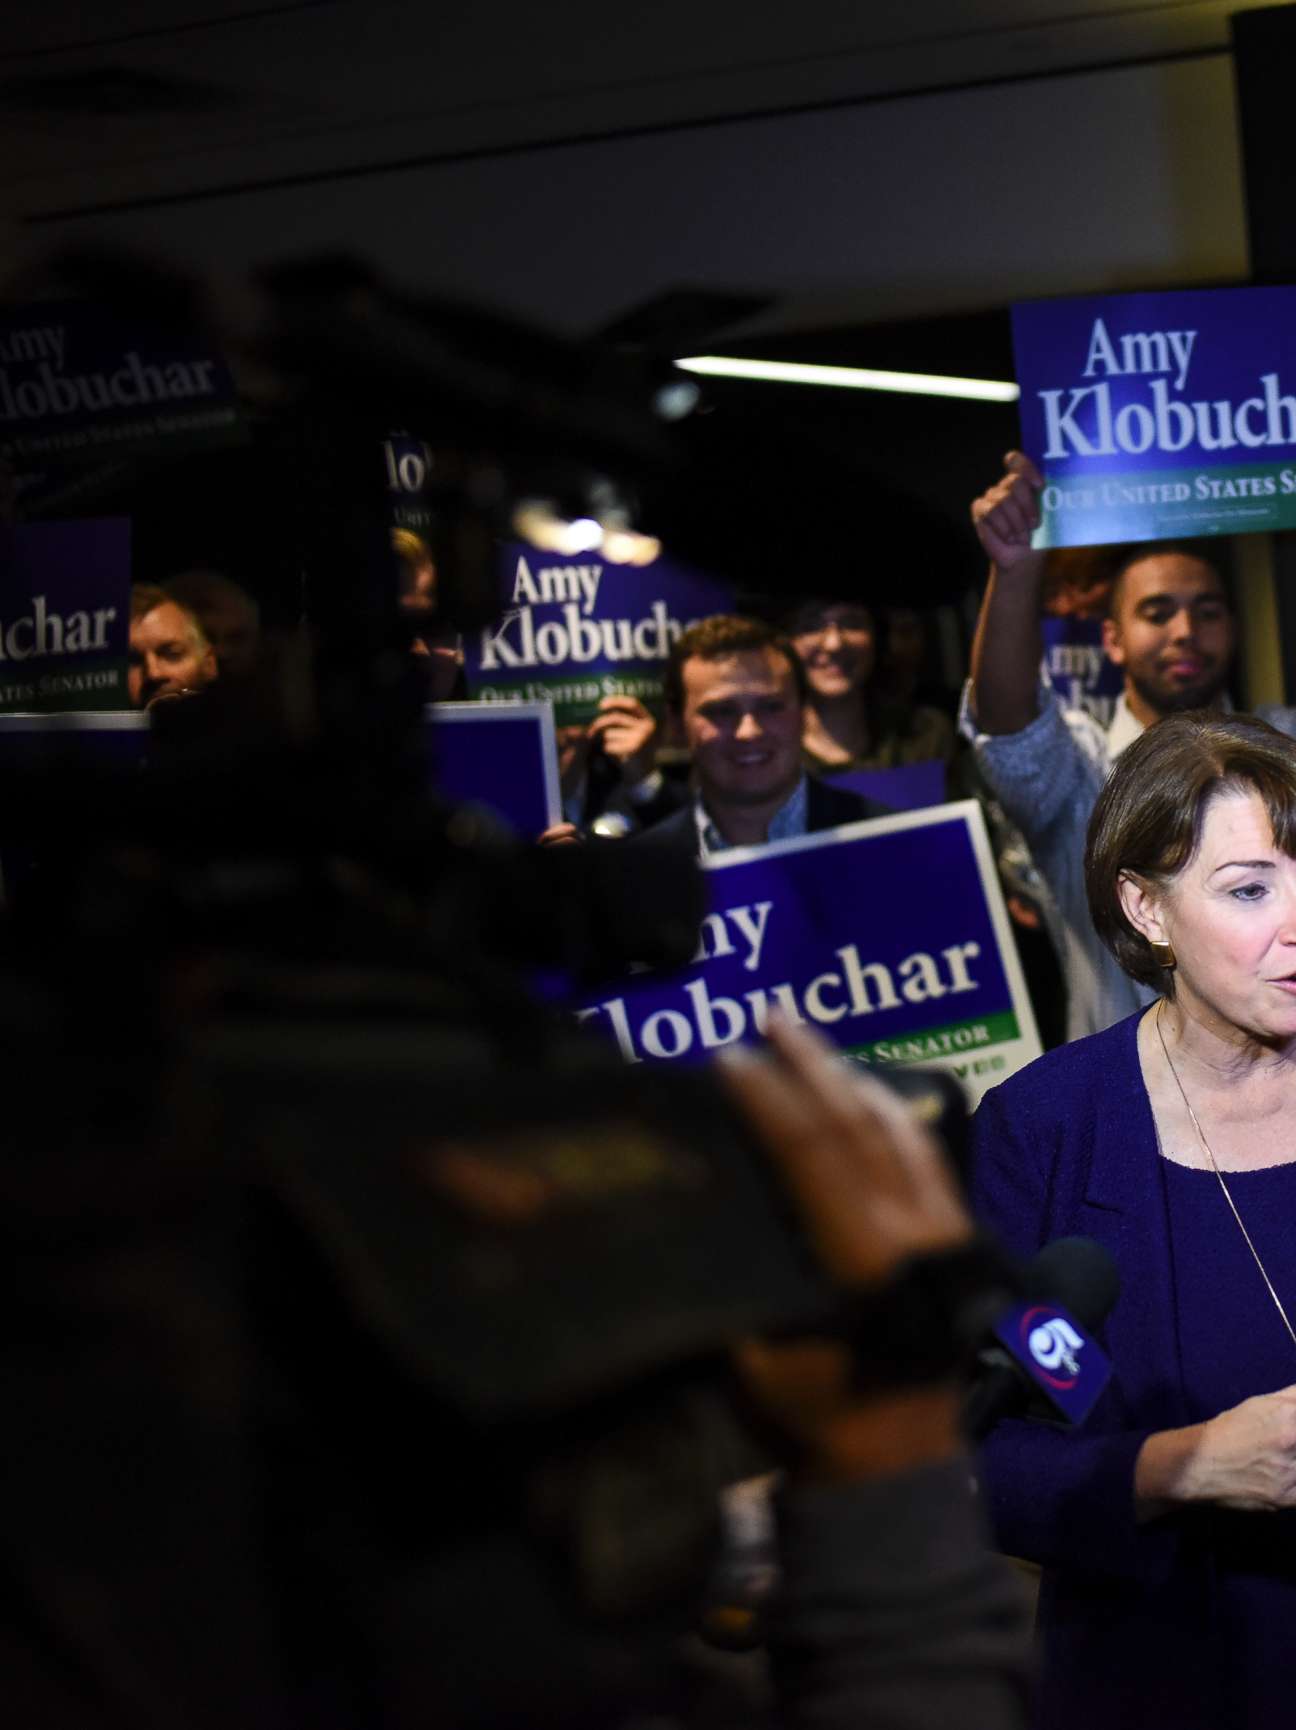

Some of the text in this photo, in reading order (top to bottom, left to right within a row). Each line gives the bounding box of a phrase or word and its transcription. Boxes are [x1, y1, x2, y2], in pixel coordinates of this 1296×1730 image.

[0, 350, 215, 423] lobuchar
[1083, 317, 1198, 392] Amy
[1194, 474, 1277, 501] STATES
[511, 554, 603, 615] Amy
[478, 599, 694, 671] Klobuch
[572, 938, 982, 1065] lobuchar
